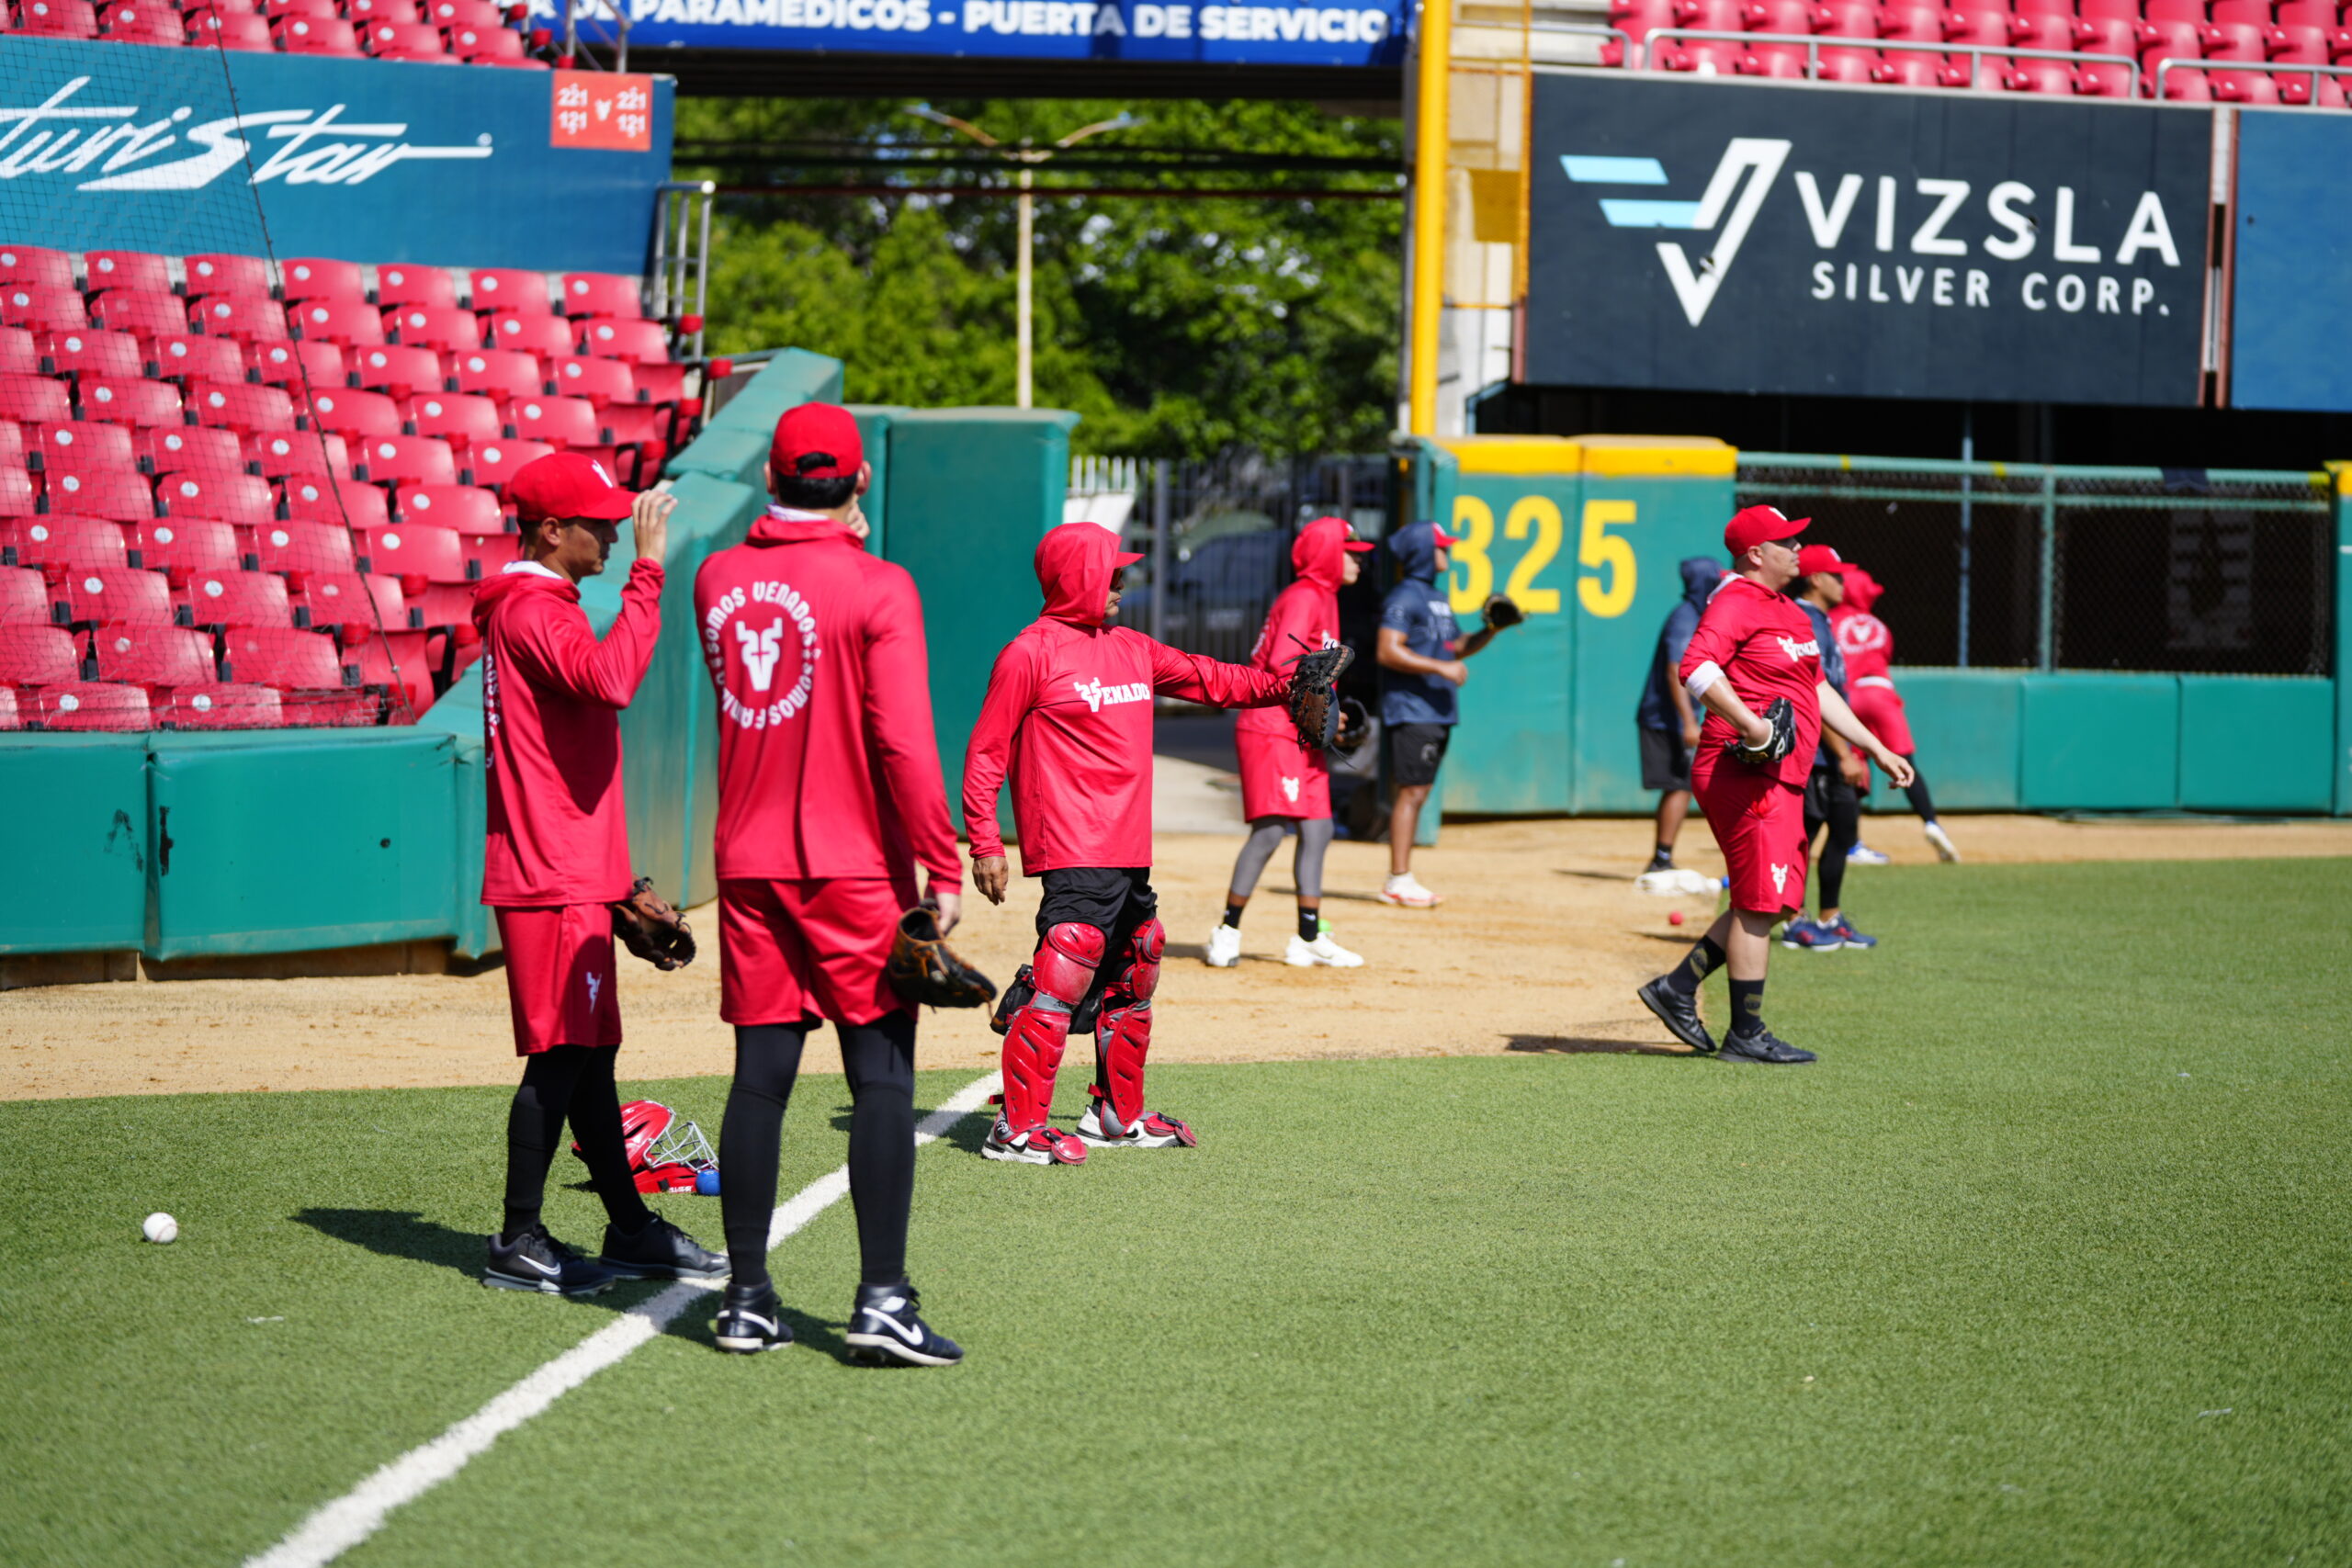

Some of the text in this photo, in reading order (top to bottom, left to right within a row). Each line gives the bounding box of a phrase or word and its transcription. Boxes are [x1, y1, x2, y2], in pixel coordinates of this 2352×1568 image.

[630, 0, 931, 31] PARAMEDICOS
[963, 3, 1126, 37] PUERTA
[1134, 6, 1192, 38] DE
[1199, 7, 1389, 43] SERVICIO
[1793, 171, 2181, 267] VIZSLA
[1812, 261, 2171, 317] SILVER CORP.
[1448, 494, 1638, 619] 325
